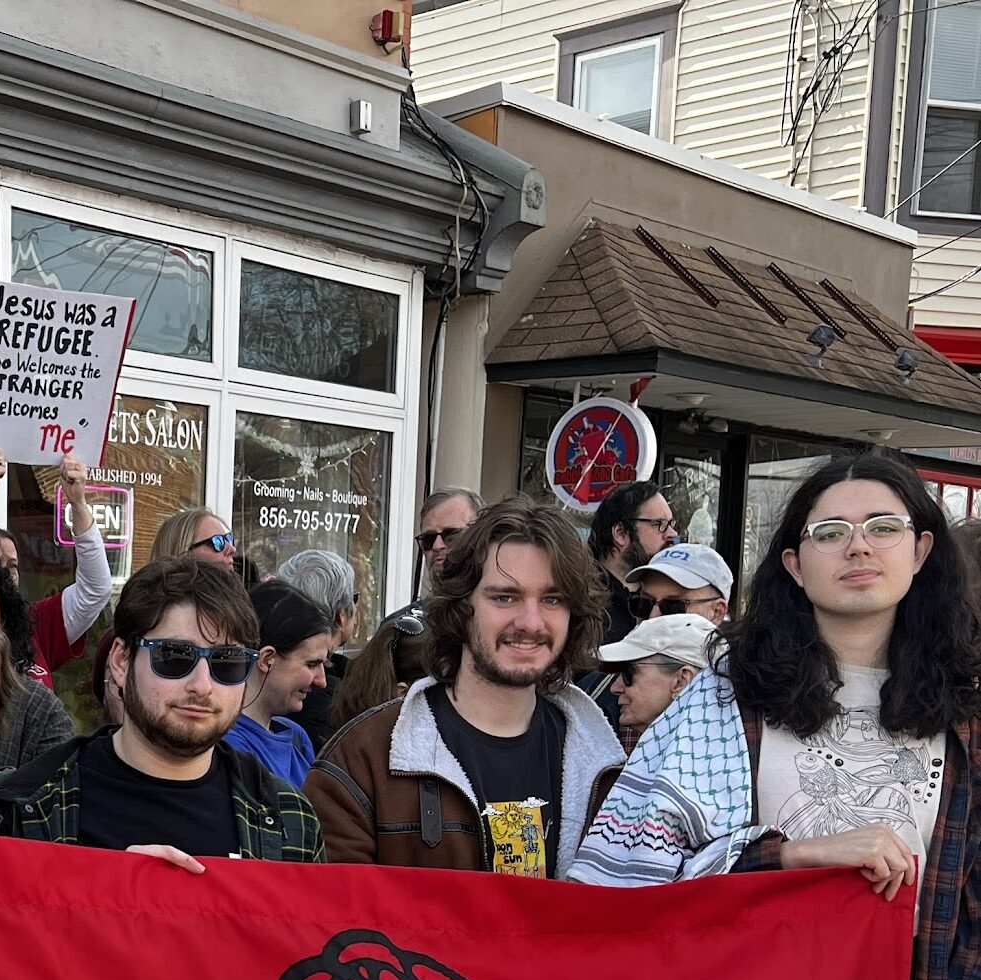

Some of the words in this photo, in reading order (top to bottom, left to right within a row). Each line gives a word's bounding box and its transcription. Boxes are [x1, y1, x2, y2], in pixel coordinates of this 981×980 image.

[64, 301, 97, 326] was
[100, 305, 118, 329] a
[80, 362, 101, 379] the
[107, 410, 140, 445] ETS
[86, 467, 137, 484] TABLISHED
[139, 471, 163, 487] 1994
[253, 481, 296, 503] Grooming
[303, 486, 324, 502] Nails
[332, 489, 368, 508] Boutique
[64, 503, 120, 530] OEN
[259, 506, 360, 534] 856-795-9777
